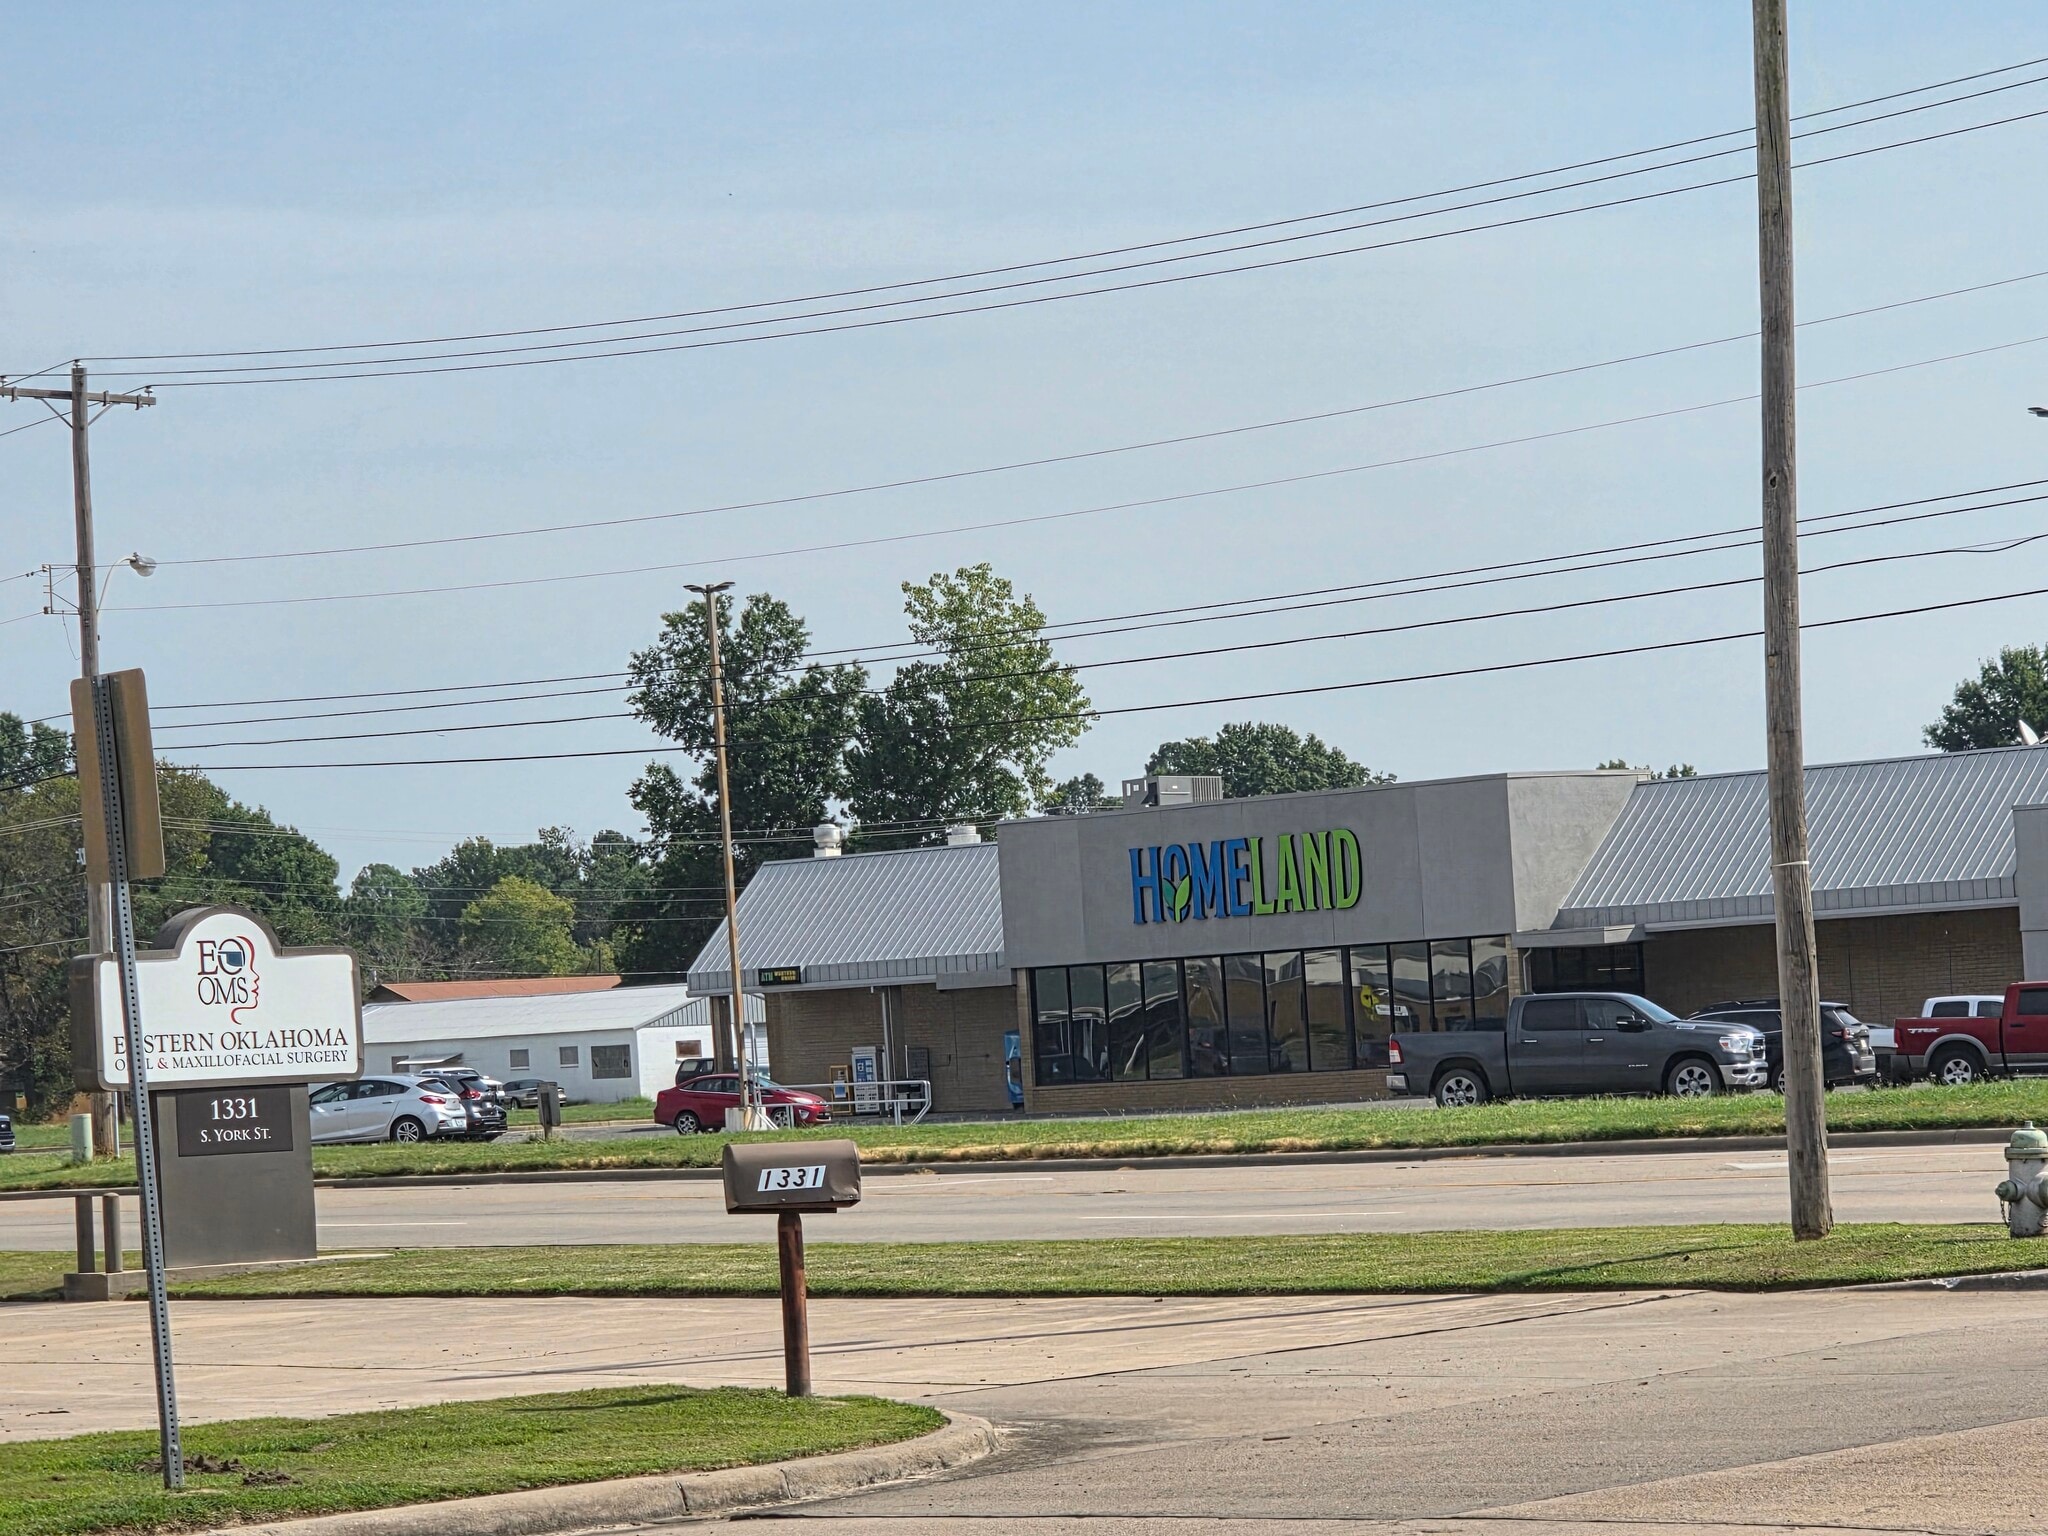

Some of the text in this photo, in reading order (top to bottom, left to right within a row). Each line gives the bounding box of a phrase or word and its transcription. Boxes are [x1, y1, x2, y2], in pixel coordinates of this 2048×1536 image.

[1128, 828, 1362, 924] HOMELAND
[198, 977, 248, 1005] OMS
[113, 1028, 349, 1055] ESTERN OKLAHOMA
[115, 1049, 349, 1072] OL & MAXILLOFACIAL SURGERY
[210, 1097, 259, 1120] 1331
[200, 1126, 272, 1143] S. YORK ST.
[764, 1167, 820, 1190] 1331
